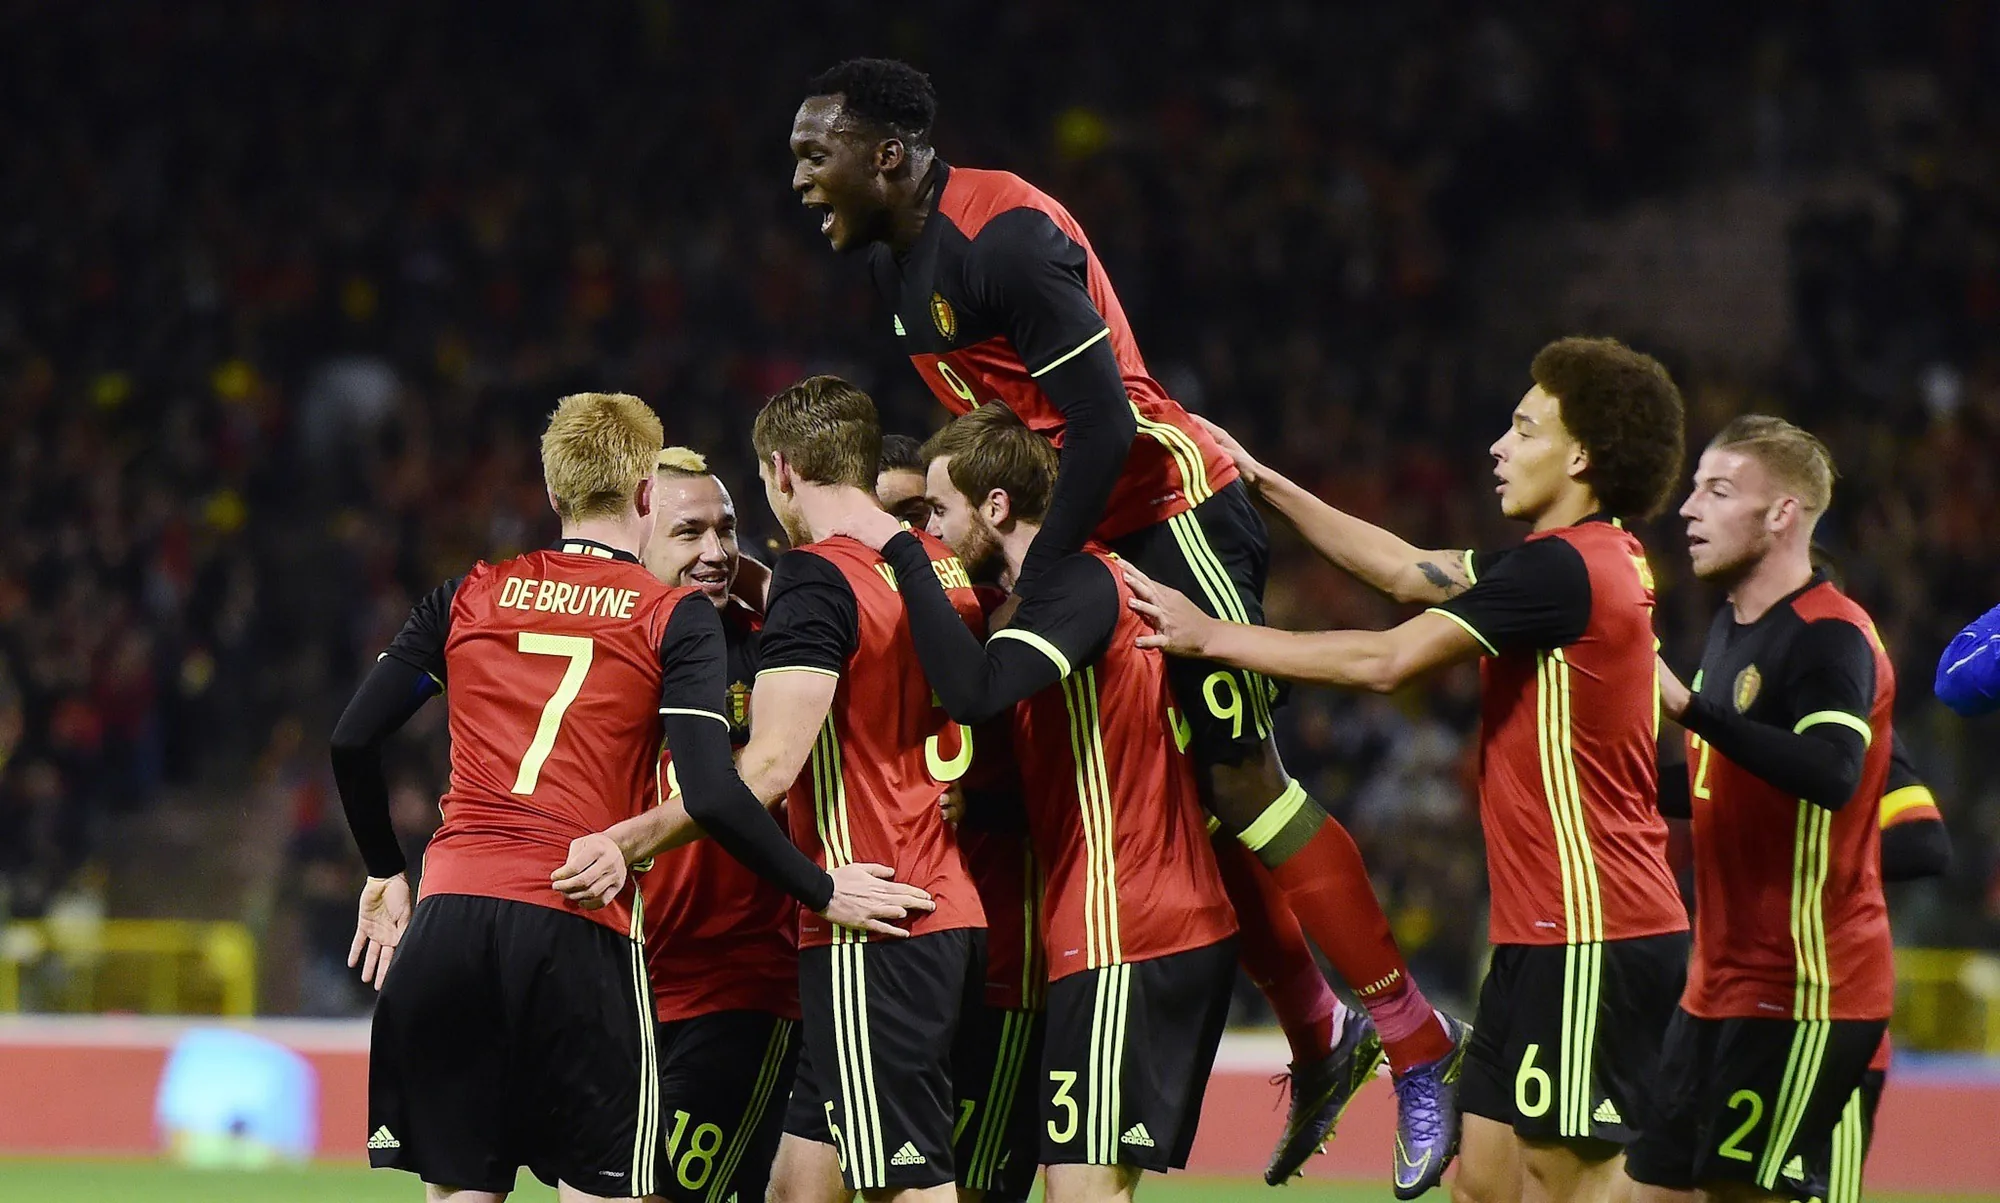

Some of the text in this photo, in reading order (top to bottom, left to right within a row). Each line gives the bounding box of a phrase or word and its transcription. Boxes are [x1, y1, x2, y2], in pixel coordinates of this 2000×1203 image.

[938, 361, 981, 410] 9
[511, 631, 594, 796] 7
[1202, 670, 1243, 739] 9
[1691, 733, 1711, 800] 2
[1047, 1070, 1079, 1144] 3
[1515, 1043, 1552, 1118] 6
[366, 1139, 401, 1150] adidas
[673, 1109, 724, 1190] 18
[890, 1154, 927, 1166] adidas
[1120, 1135, 1155, 1148] adidas
[1718, 1089, 1764, 1162] 2
